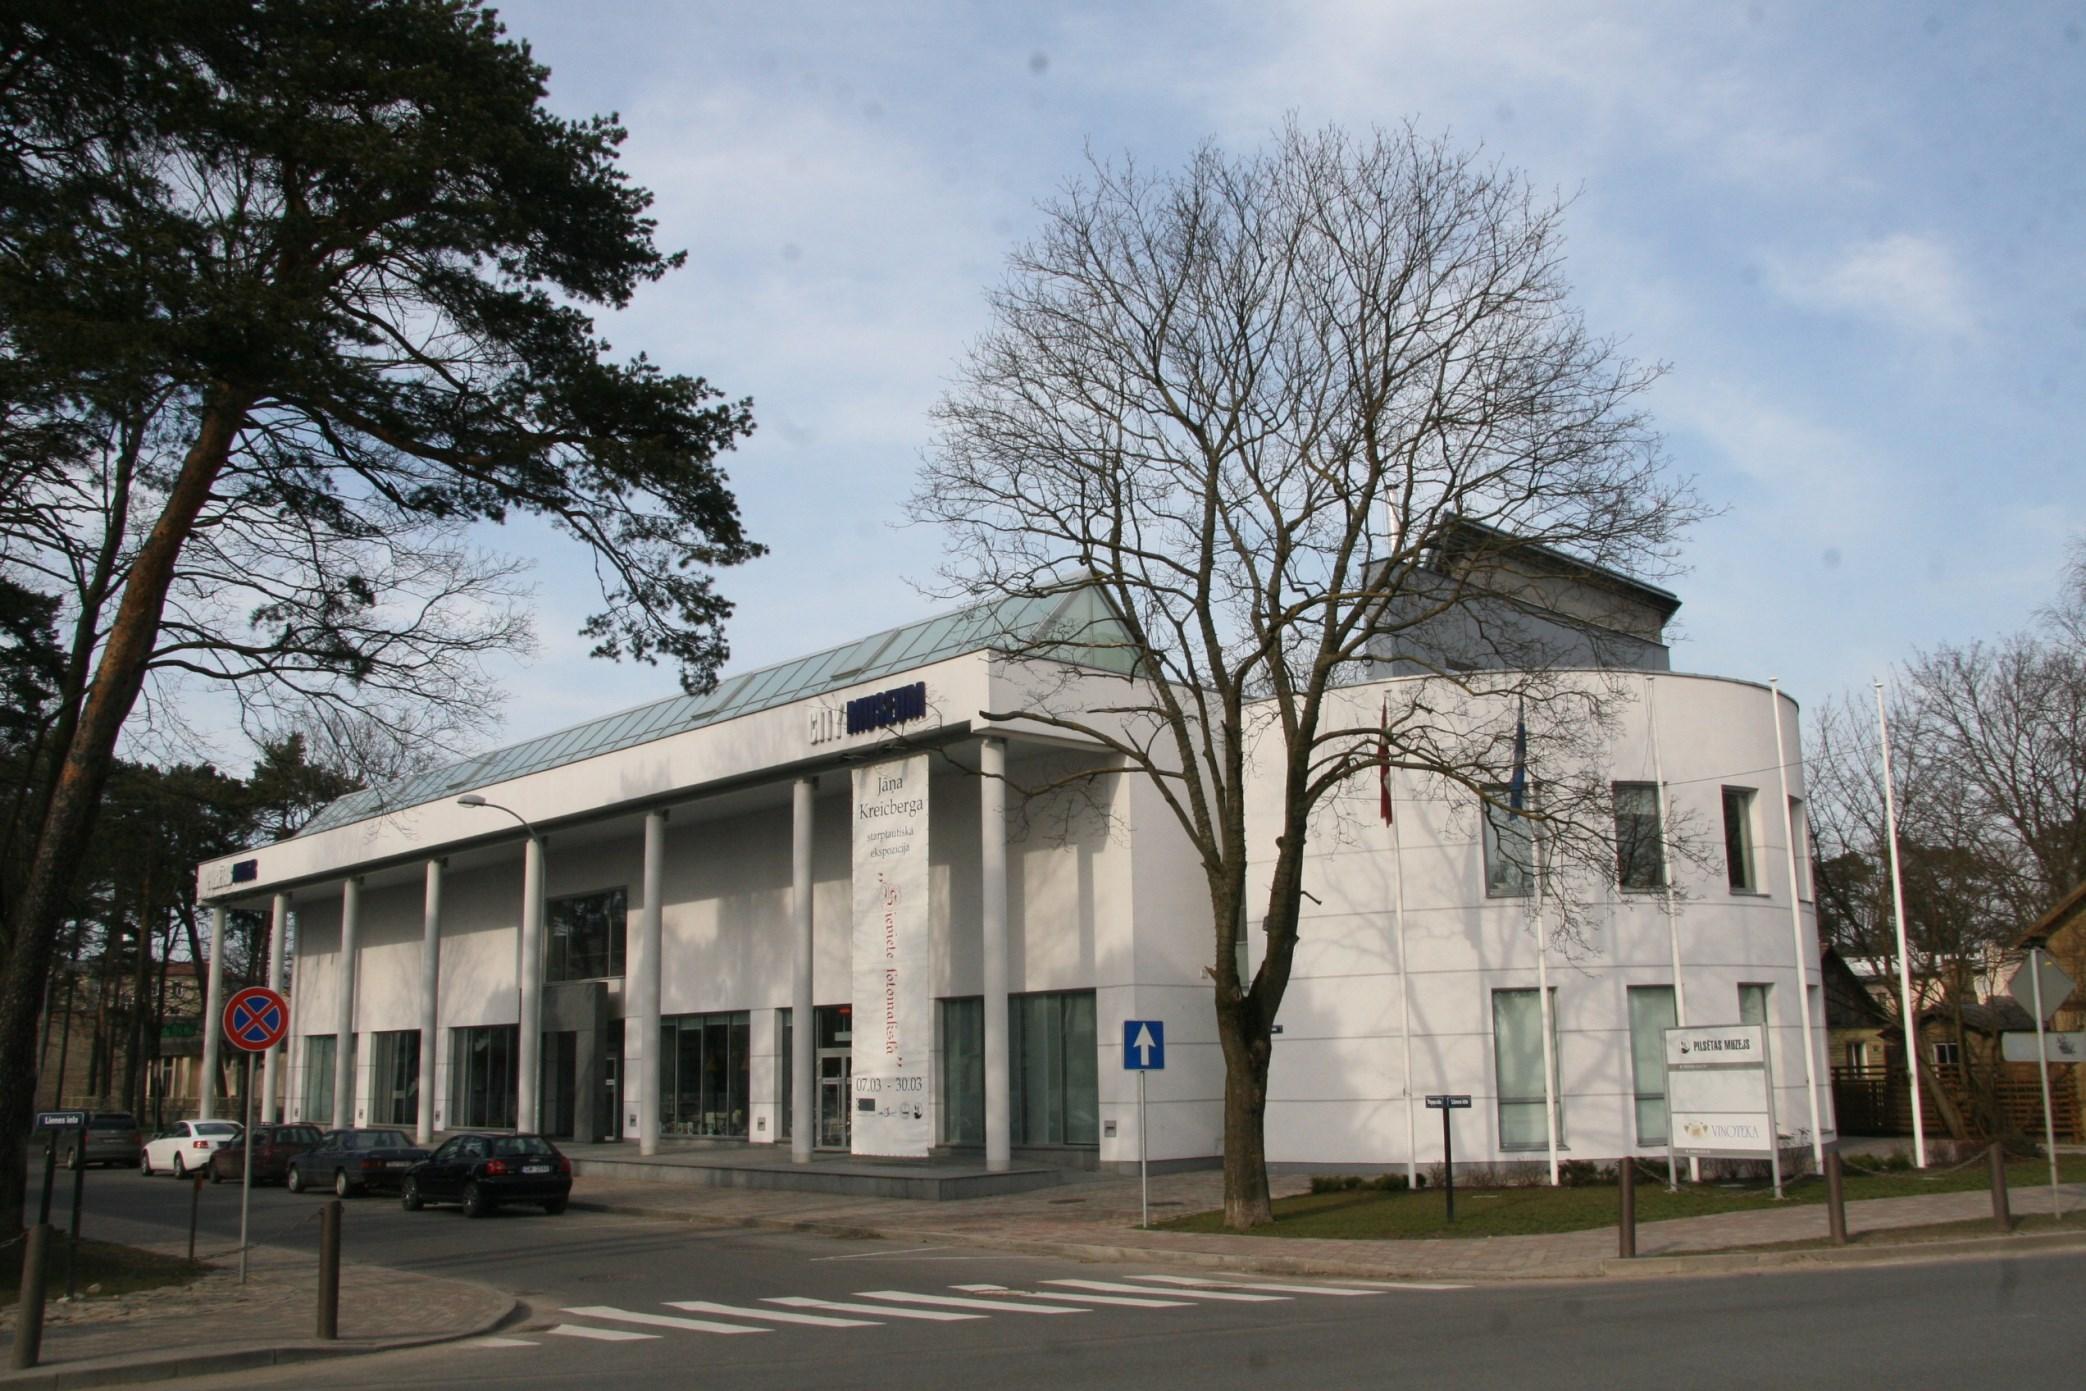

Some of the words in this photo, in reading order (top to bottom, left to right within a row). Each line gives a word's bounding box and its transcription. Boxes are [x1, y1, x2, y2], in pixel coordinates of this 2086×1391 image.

[859, 798, 923, 820] Kreicberga
[856, 1077, 881, 1092] 07.03
[896, 1077, 922, 1092] 30.03
[1711, 1125, 1759, 1138] VINOTEKA
